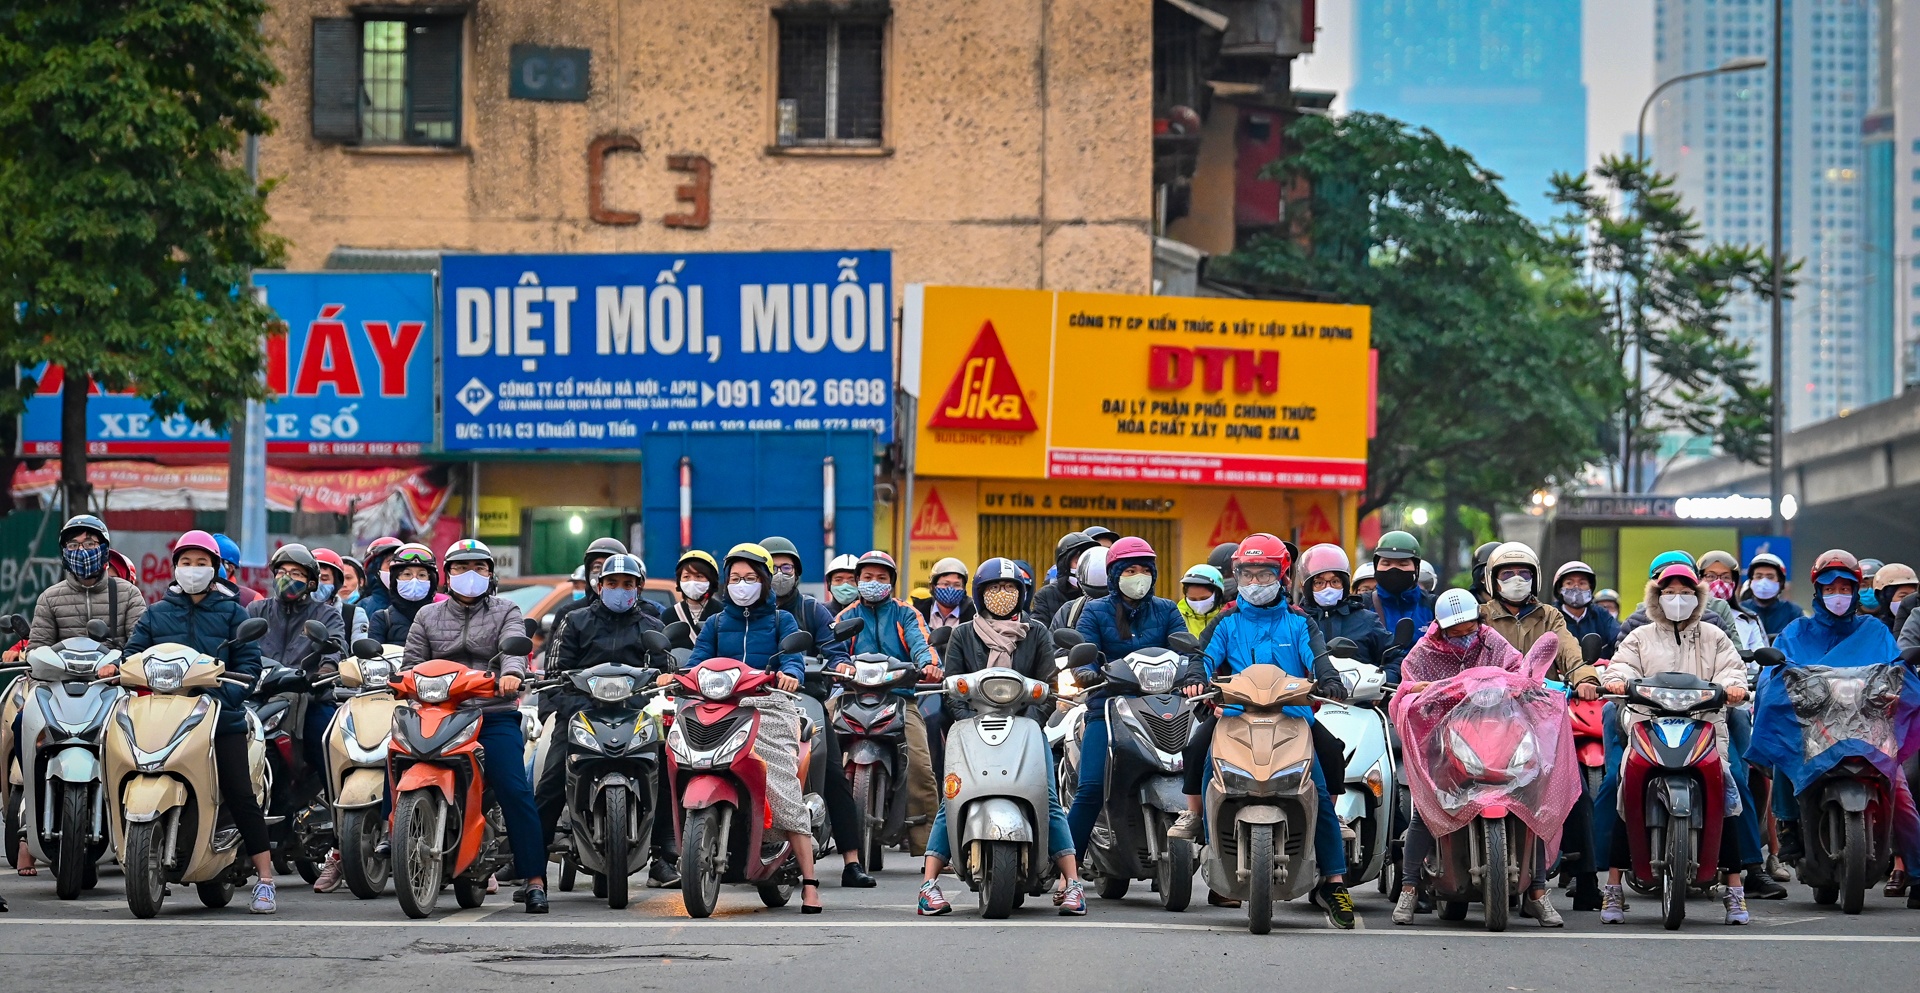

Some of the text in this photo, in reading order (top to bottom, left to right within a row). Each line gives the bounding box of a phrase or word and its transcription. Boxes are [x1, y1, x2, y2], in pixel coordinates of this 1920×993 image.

[522, 57, 575, 89] C3
[455, 257, 886, 373] DIỆT MỐI, MUỖI
[1069, 311, 1103, 328] CÔNG
[1108, 316, 1121, 329] TY
[1126, 316, 1143, 329] CP
[1147, 313, 1177, 332] KIẾN
[1183, 315, 1214, 334] TRÚC
[1233, 319, 1255, 338] VẬT
[1259, 320, 1286, 338] LIỆU
[1291, 321, 1315, 338] XÂY
[1319, 325, 1353, 342] DỰNG
[1147, 343, 1280, 395] DTH
[499, 379, 535, 397] CÔNG
[537, 381, 553, 396] TY
[614, 378, 633, 395] HÀ
[635, 378, 659, 398] NỘI
[669, 380, 697, 395] APN
[716, 378, 886, 407] 091 302 6698
[945, 356, 1022, 420] Sika
[98, 414, 151, 439] XE
[309, 403, 361, 439] SỐ
[1101, 399, 1126, 419] ĐẠI
[1194, 398, 1228, 419] PHỐI
[1234, 401, 1276, 420] CHÍNH
[1282, 402, 1317, 421] THỨC
[486, 423, 513, 439] 114
[515, 422, 534, 439] C3
[536, 419, 576, 439] Khuất
[579, 421, 605, 440] Duy
[607, 419, 637, 438] Tiến
[934, 431, 1025, 445] BUILDING TRUST
[1190, 418, 1217, 437] XÂY
[1225, 422, 1262, 442] DỰNG
[1268, 424, 1300, 440] SIKA
[985, 493, 1005, 507] UY
[1010, 491, 1035, 508] TÍN
[1662, 718, 1686, 726] SYM
